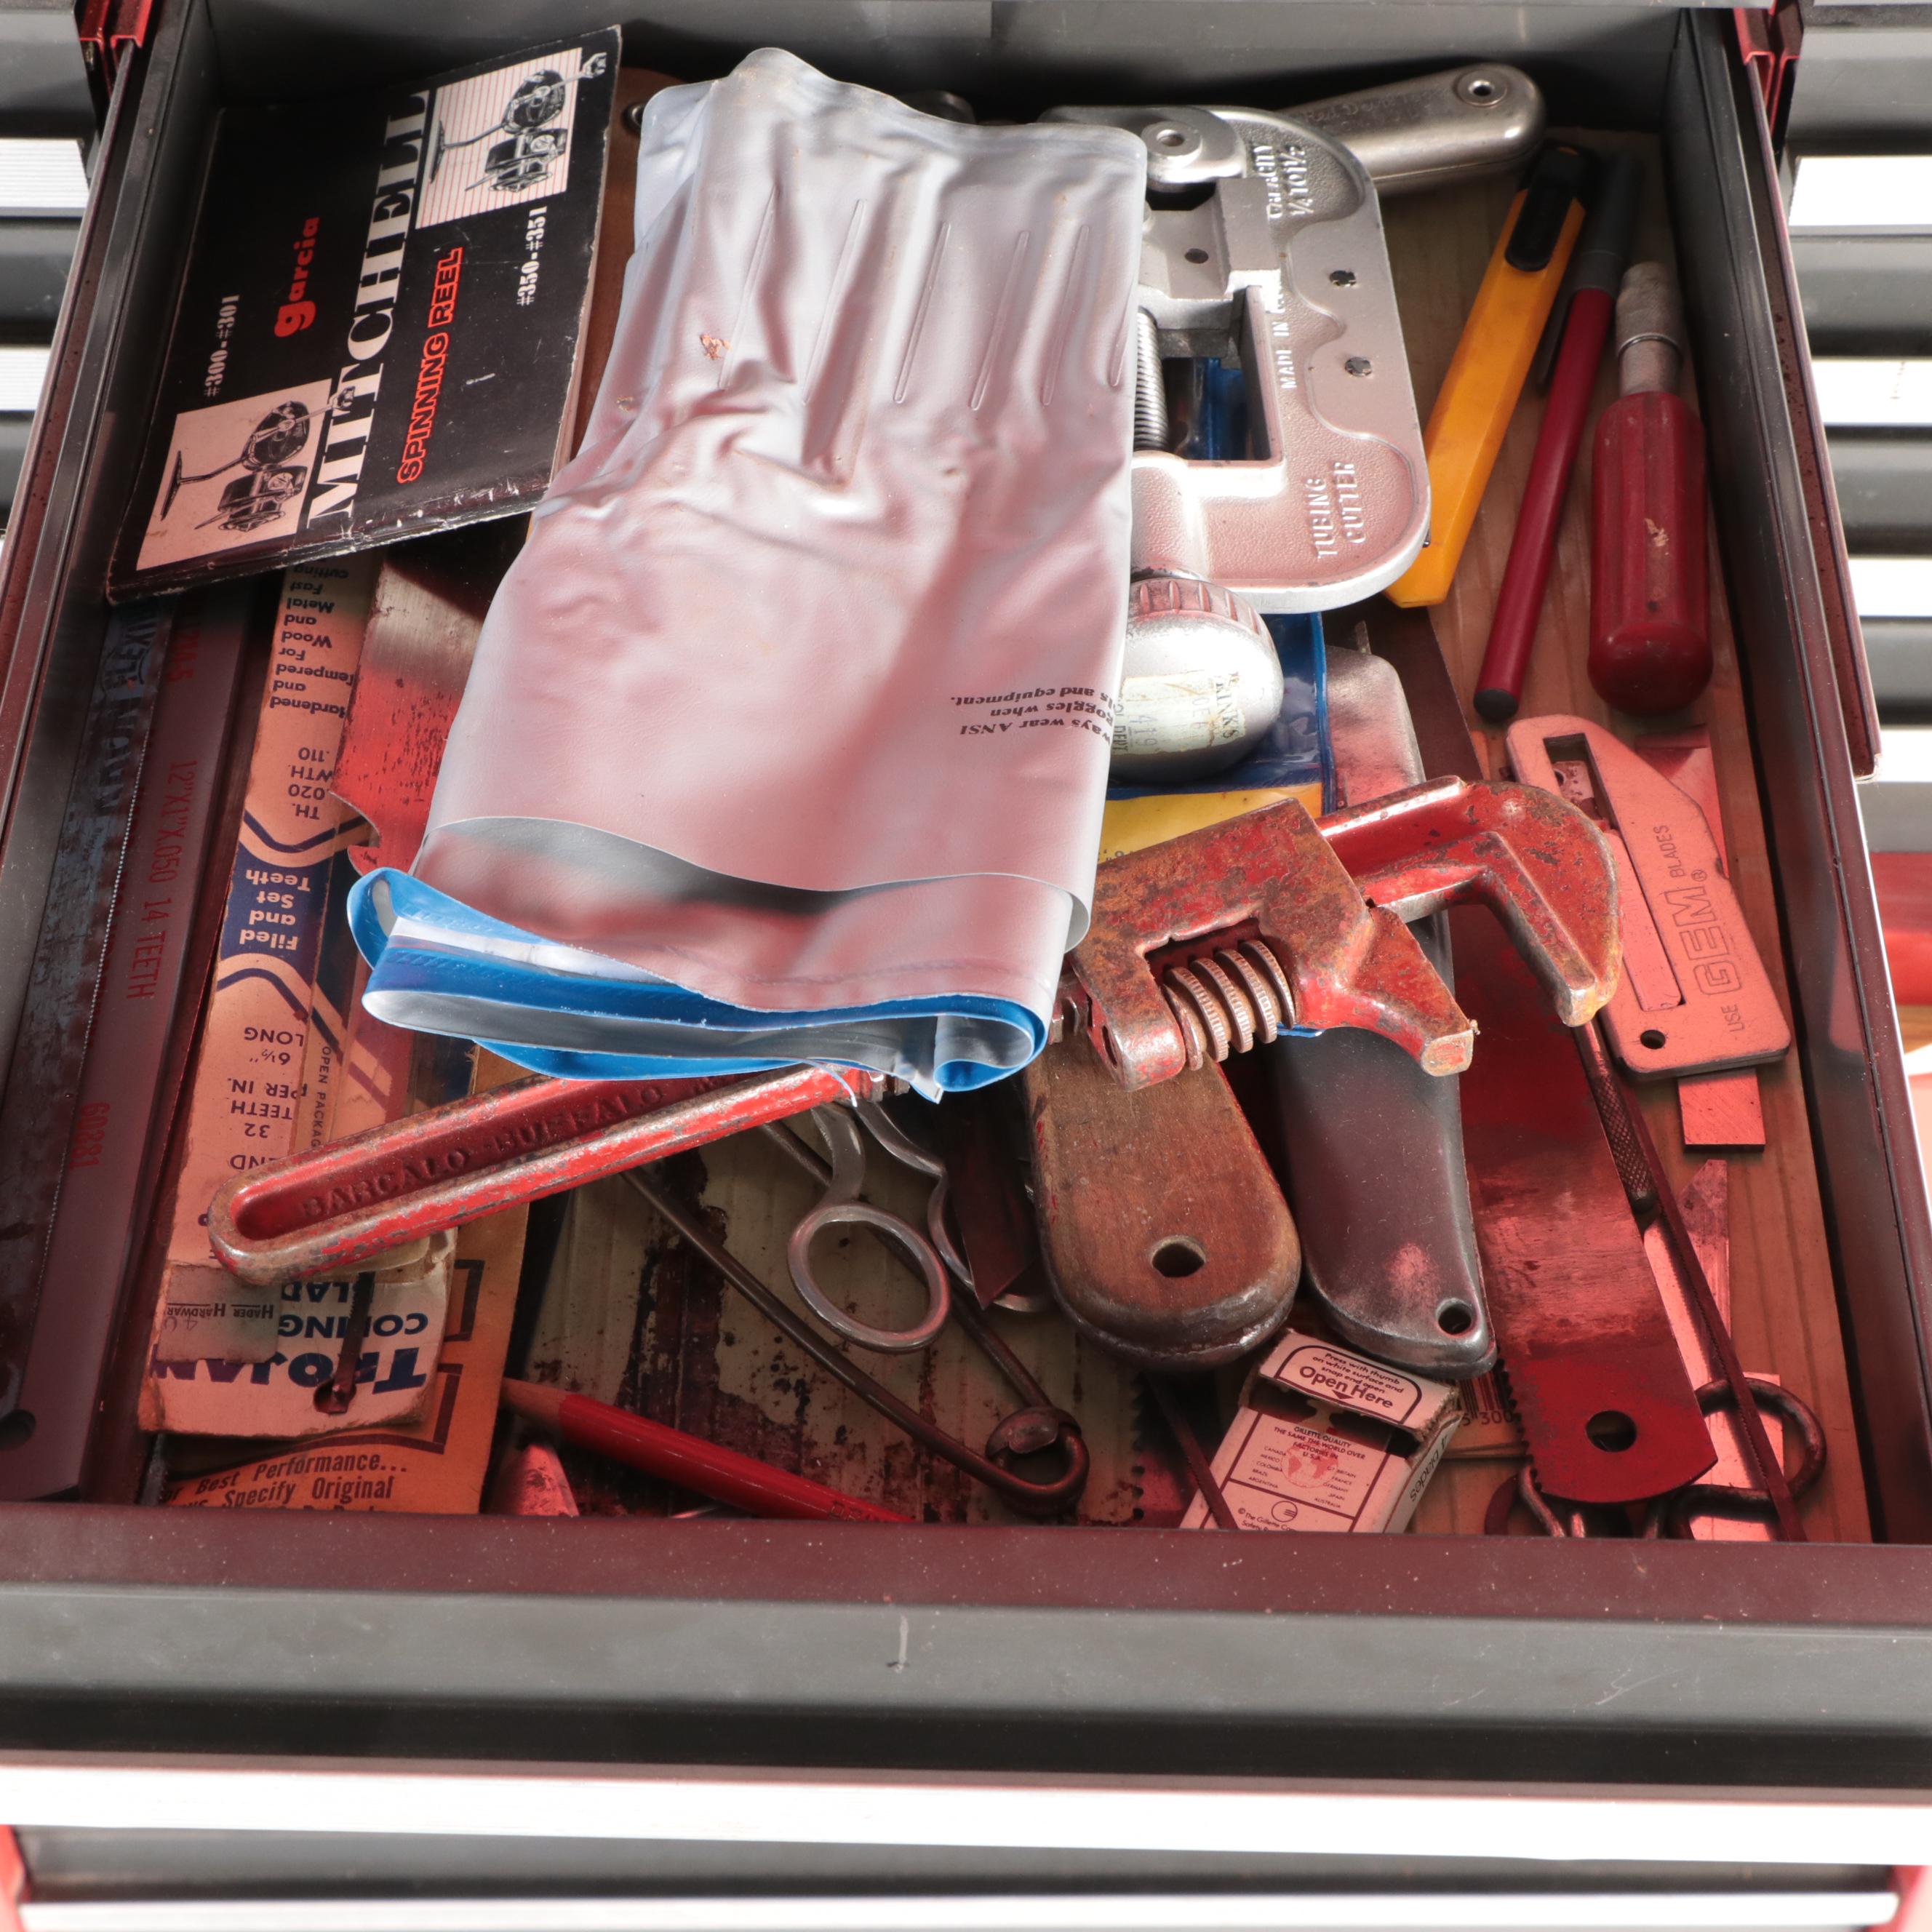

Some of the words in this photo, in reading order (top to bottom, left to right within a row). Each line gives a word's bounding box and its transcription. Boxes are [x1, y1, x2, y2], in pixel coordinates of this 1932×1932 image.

[516, 205, 548, 307] #350-#351
[274, 217, 320, 338] garcia
[308, 89, 431, 530] MITCHELL
[1272, 322, 1289, 337] IN
[204, 293, 241, 398] #300-#301
[396, 331, 450, 485] SPINNING
[428, 247, 463, 328] REEL
[1276, 350, 1297, 388] MADE
[1334, 462, 1366, 543] CUTTER
[1304, 479, 1338, 559] TUBING
[290, 581, 323, 595] Fast
[287, 597, 335, 614] Metal
[284, 614, 317, 626] and
[282, 631, 332, 648] Wood
[279, 647, 306, 660] For
[273, 679, 306, 692] and
[276, 663, 356, 687] Tempered
[951, 687, 1056, 706] equipment.
[1060, 686, 1095, 698] and
[990, 704, 1039, 717] when
[959, 722, 1013, 735] ANSI
[1019, 718, 1064, 729] wear
[292, 803, 320, 821] TH.
[1653, 825, 1685, 879] BLADES
[246, 869, 311, 892] Teeth
[141, 898, 172, 922] 14
[256, 890, 295, 908] Set
[249, 910, 296, 925] and
[239, 930, 298, 951] Filed
[1664, 886, 1743, 995] GEM
[127, 930, 167, 1000] TEETH
[1721, 1004, 1744, 1032] USE
[244, 1026, 304, 1047] LONG
[319, 1046, 332, 1085] OPEN
[227, 1078, 254, 1095] IN.
[266, 1082, 308, 1099] PER
[231, 1100, 293, 1121] TEETH
[310, 1092, 327, 1148] PACKAG
[244, 1123, 271, 1138] 32
[166, 1303, 225, 1318] HARDWAR
[233, 1304, 274, 1320] HADER
[1325, 1353, 1346, 1364] Press
[1349, 1362, 1368, 1373] with
[1370, 1369, 1400, 1384] thumb
[1326, 1361, 1351, 1373] white
[1352, 1371, 1384, 1386] surface
[1385, 1384, 1404, 1394] and
[1299, 1366, 1349, 1392] Open
[1351, 1384, 1393, 1408] Here
[1321, 1367, 1343, 1378] snap
[1344, 1376, 1362, 1385] end
[1363, 1383, 1385, 1394] open
[1274, 1426, 1288, 1434] THE
[1288, 1431, 1306, 1441] SAME
[1322, 1442, 1346, 1453] WORLD
[1346, 1450, 1366, 1460] OVER
[1322, 1435, 1352, 1448] QUALITY
[196, 1472, 241, 1495] Best
[1410, 1450, 1440, 1502] blades
[223, 1481, 297, 1509] Specify
[312, 1475, 396, 1504] Original
[1245, 1513, 1256, 1521] The
